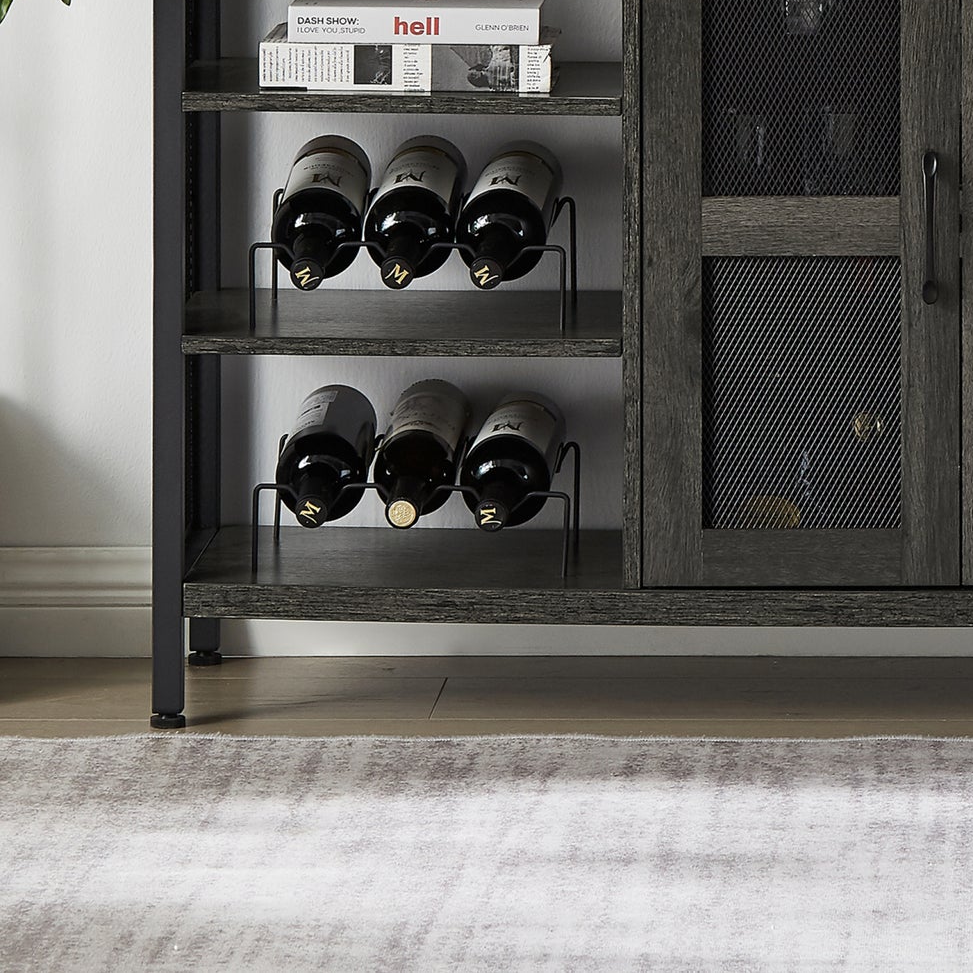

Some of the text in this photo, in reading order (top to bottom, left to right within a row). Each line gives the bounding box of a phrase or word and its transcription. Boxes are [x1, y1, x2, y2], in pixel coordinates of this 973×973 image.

[297, 16, 360, 25] DASH SHOW:
[393, 16, 440, 36] hell
[501, 23, 529, 31] O'BRIEN
